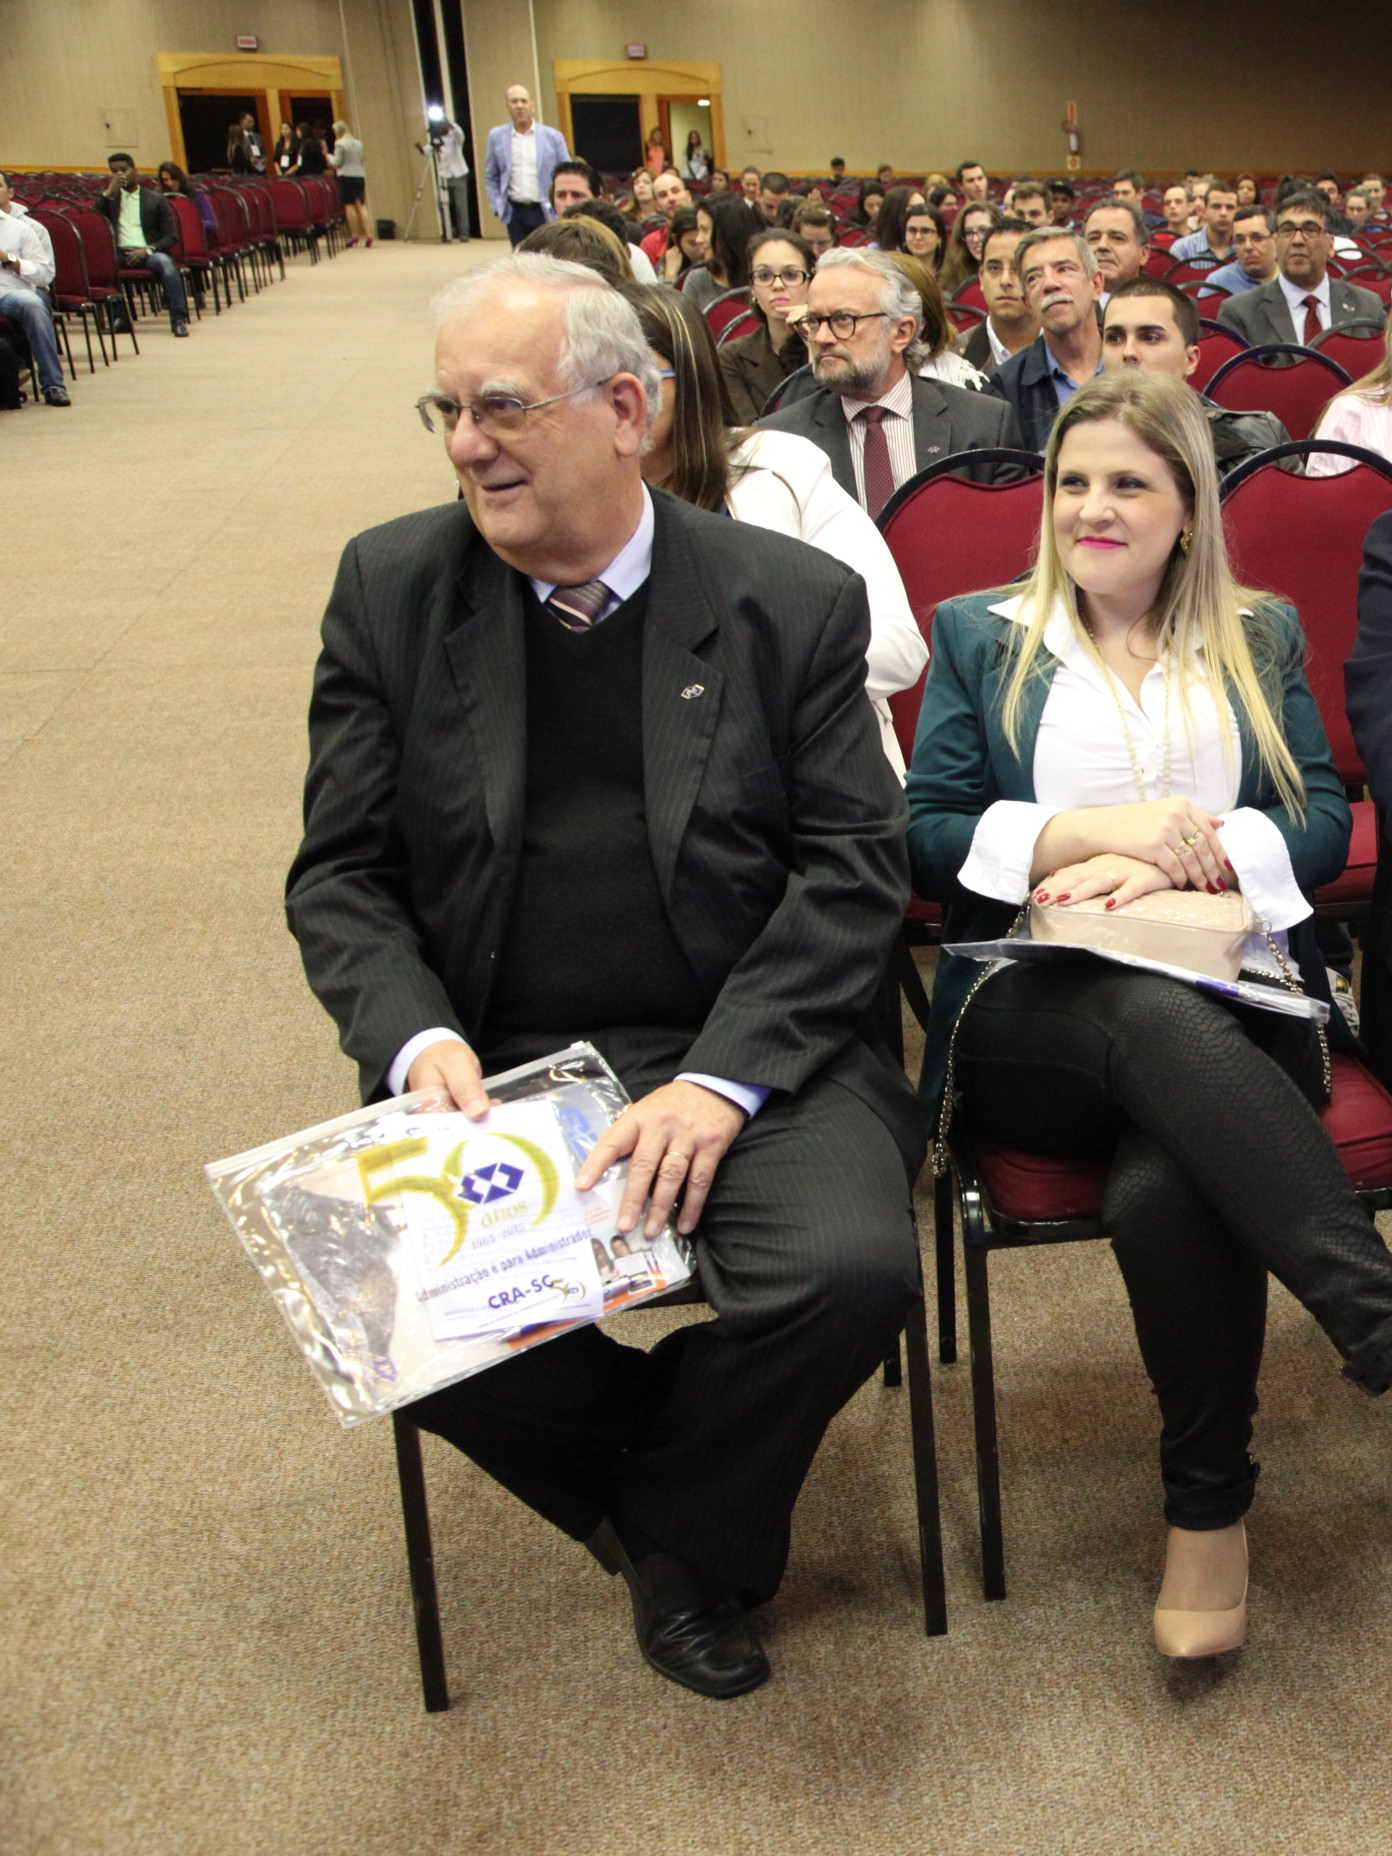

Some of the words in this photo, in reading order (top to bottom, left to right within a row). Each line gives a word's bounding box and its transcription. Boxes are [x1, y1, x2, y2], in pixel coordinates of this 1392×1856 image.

[480, 1201, 529, 1228] anos
[500, 1255, 524, 1273] para
[524, 1228, 592, 1261] Administrador
[488, 1274, 554, 1309] CRA-SC
